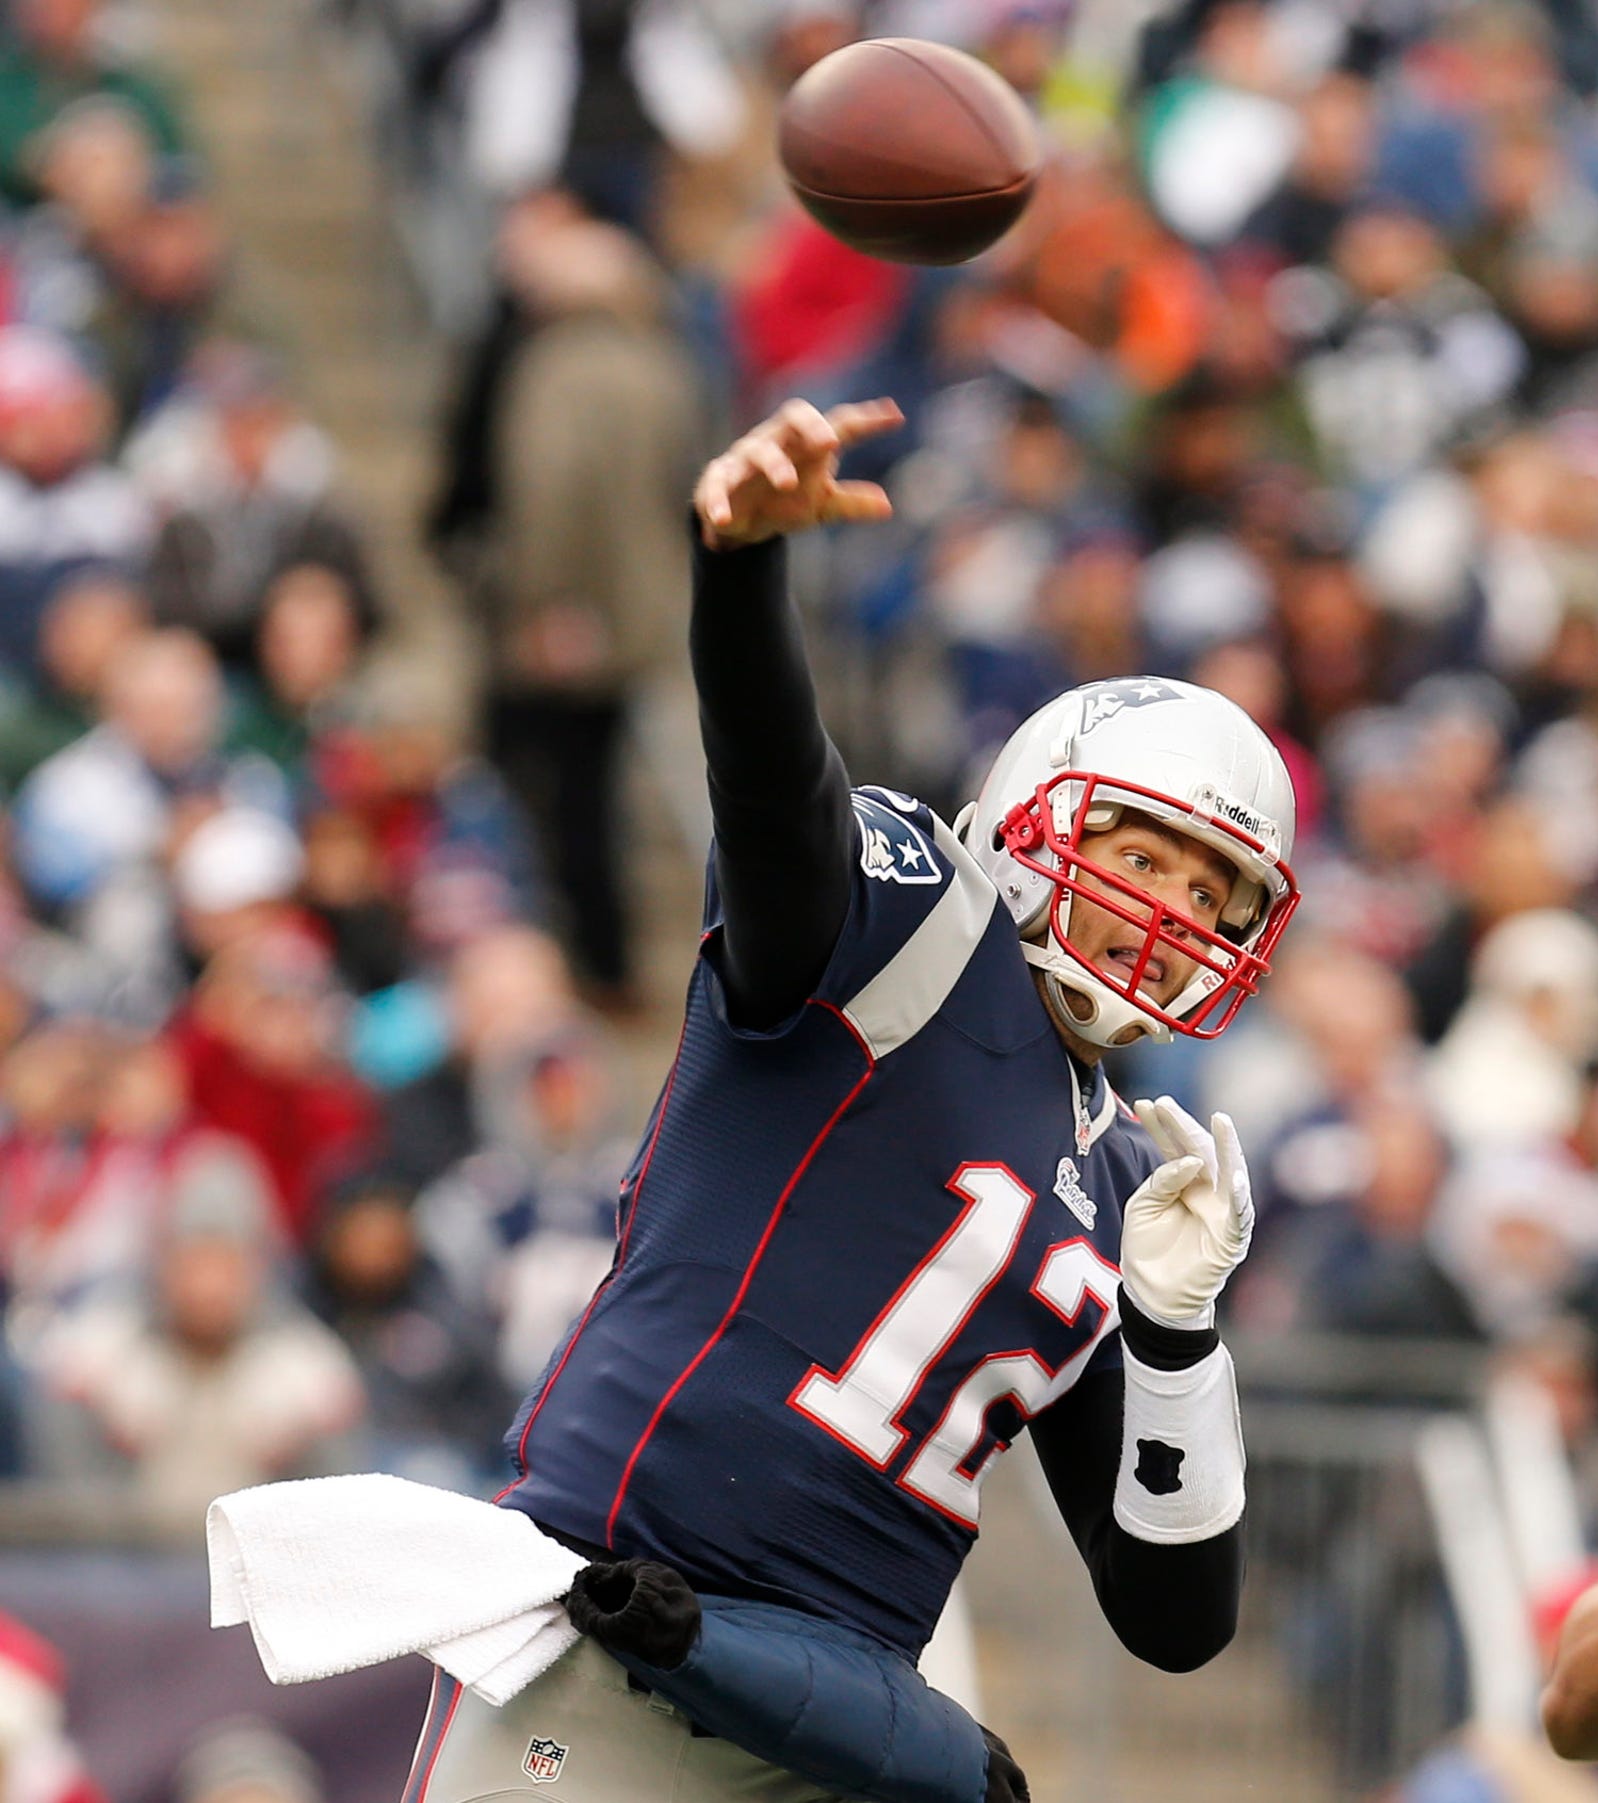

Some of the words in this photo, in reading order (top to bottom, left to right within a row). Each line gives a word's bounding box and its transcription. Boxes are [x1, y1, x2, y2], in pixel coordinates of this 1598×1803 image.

[1213, 796, 1261, 835] Riddell
[786, 1161, 1123, 1530] 12
[527, 1753, 556, 1777] NFL
